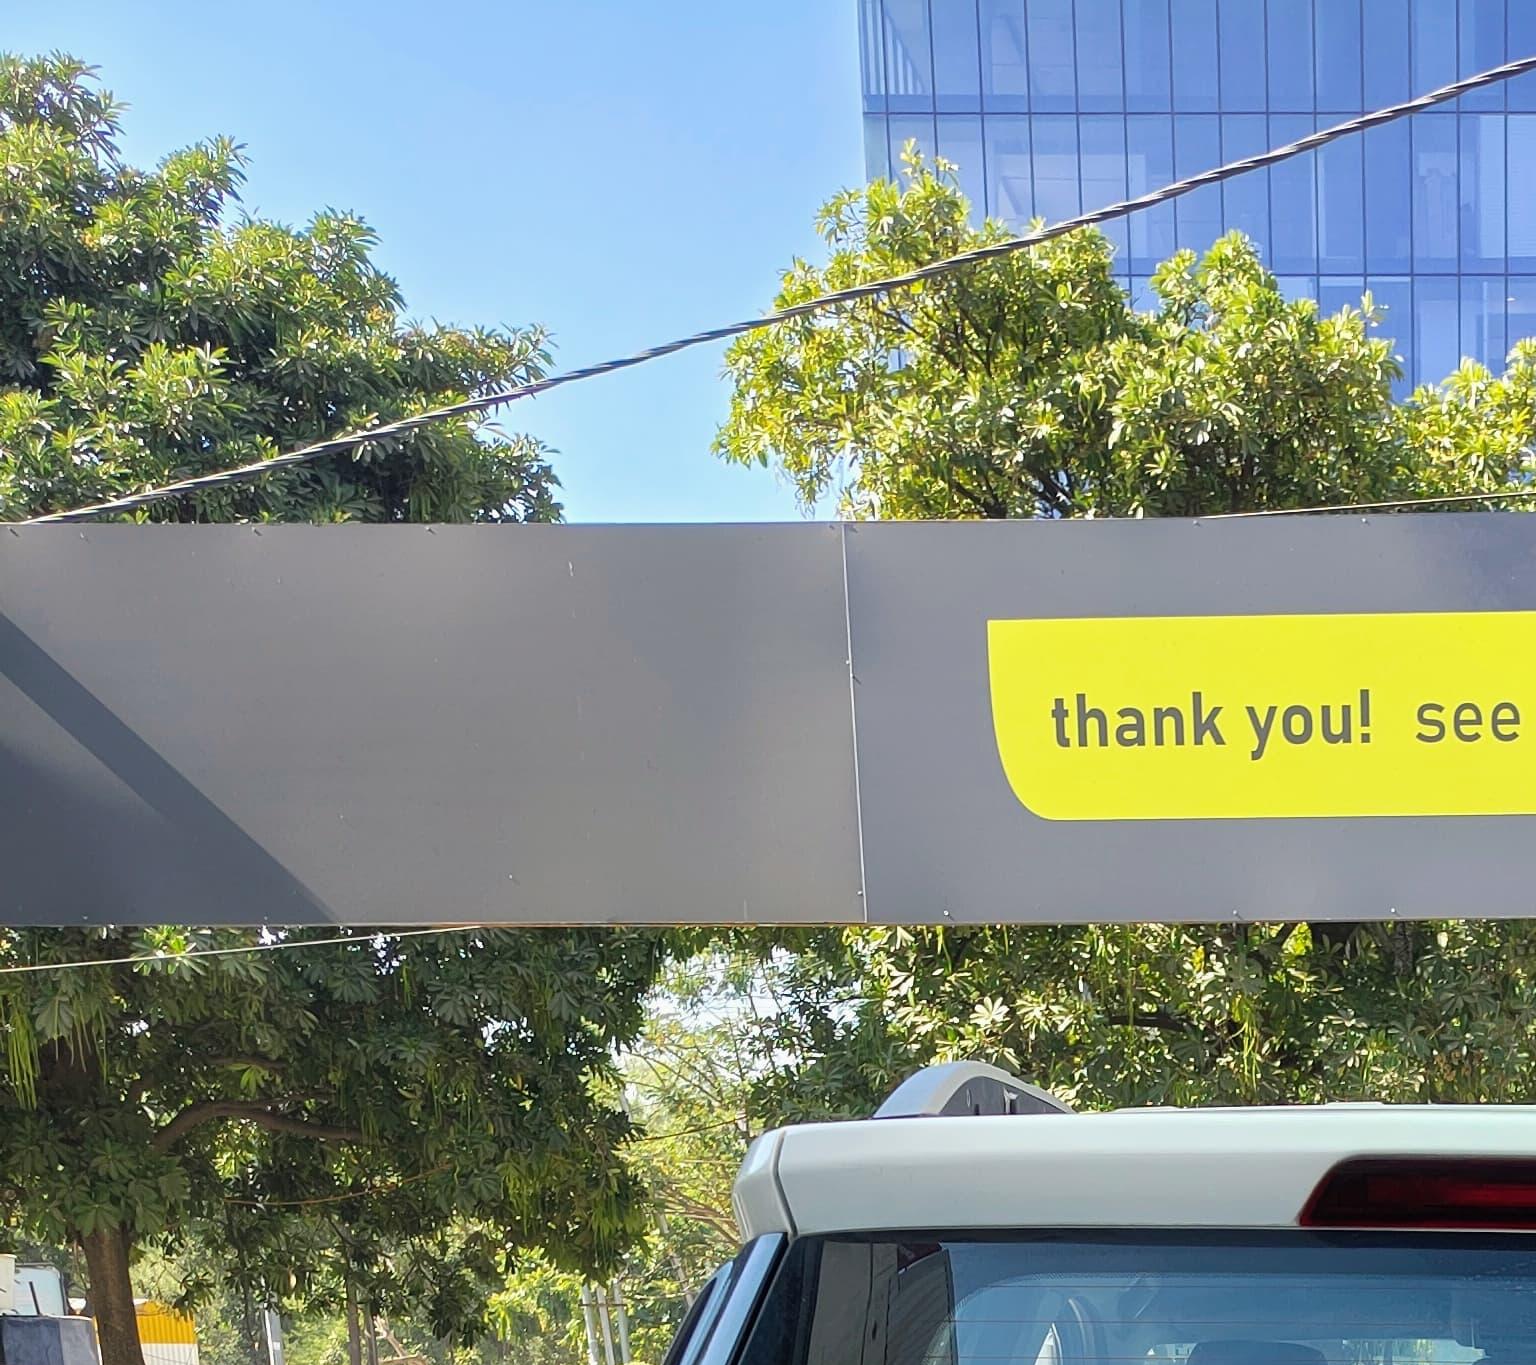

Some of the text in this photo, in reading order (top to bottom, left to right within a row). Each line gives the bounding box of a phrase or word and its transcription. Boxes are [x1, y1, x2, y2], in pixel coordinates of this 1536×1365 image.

[1051, 690, 1228, 750] thank
[1245, 687, 1373, 762] you!
[1414, 699, 1522, 745] see
